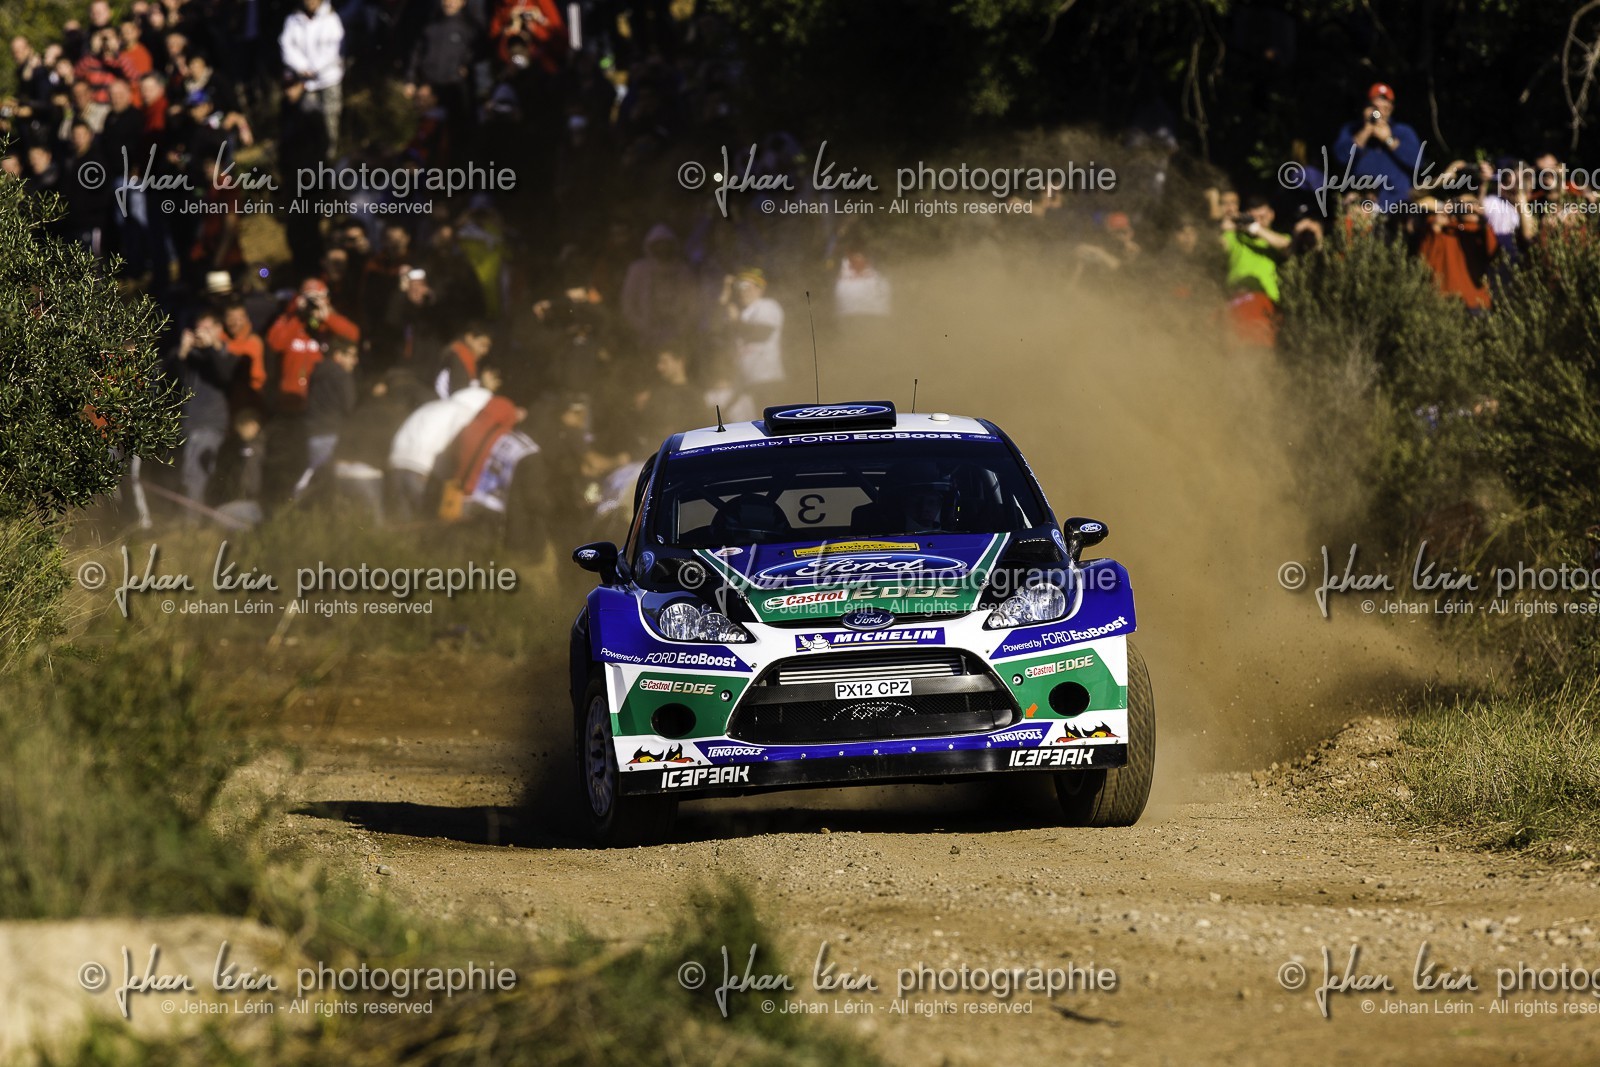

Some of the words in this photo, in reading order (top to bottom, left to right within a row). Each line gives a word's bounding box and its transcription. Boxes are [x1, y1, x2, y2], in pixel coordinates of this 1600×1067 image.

[796, 407, 867, 418] Ford
[711, 441, 765, 452] Powered
[789, 434, 849, 444] FORD
[853, 432, 962, 440] EcoBoost
[796, 556, 926, 577] Ford
[785, 590, 844, 605] Castrol
[851, 586, 961, 600] EDGE
[854, 613, 883, 625] Ford
[833, 630, 938, 643] MICHELIN
[1002, 639, 1033, 652] Powered
[1033, 640, 1043, 648] by
[1041, 631, 1071, 646] FORD
[1069, 615, 1128, 640] EcoBoost
[600, 648, 633, 661] Powered
[644, 653, 677, 664] FORD
[676, 652, 737, 667] EcoBoost
[1033, 665, 1055, 676] Castrol
[1056, 655, 1094, 672] EDGE
[647, 681, 671, 691] Castrol
[672, 682, 717, 695] EDGE
[837, 683, 873, 697] PX12
[878, 681, 910, 695] CPZ
